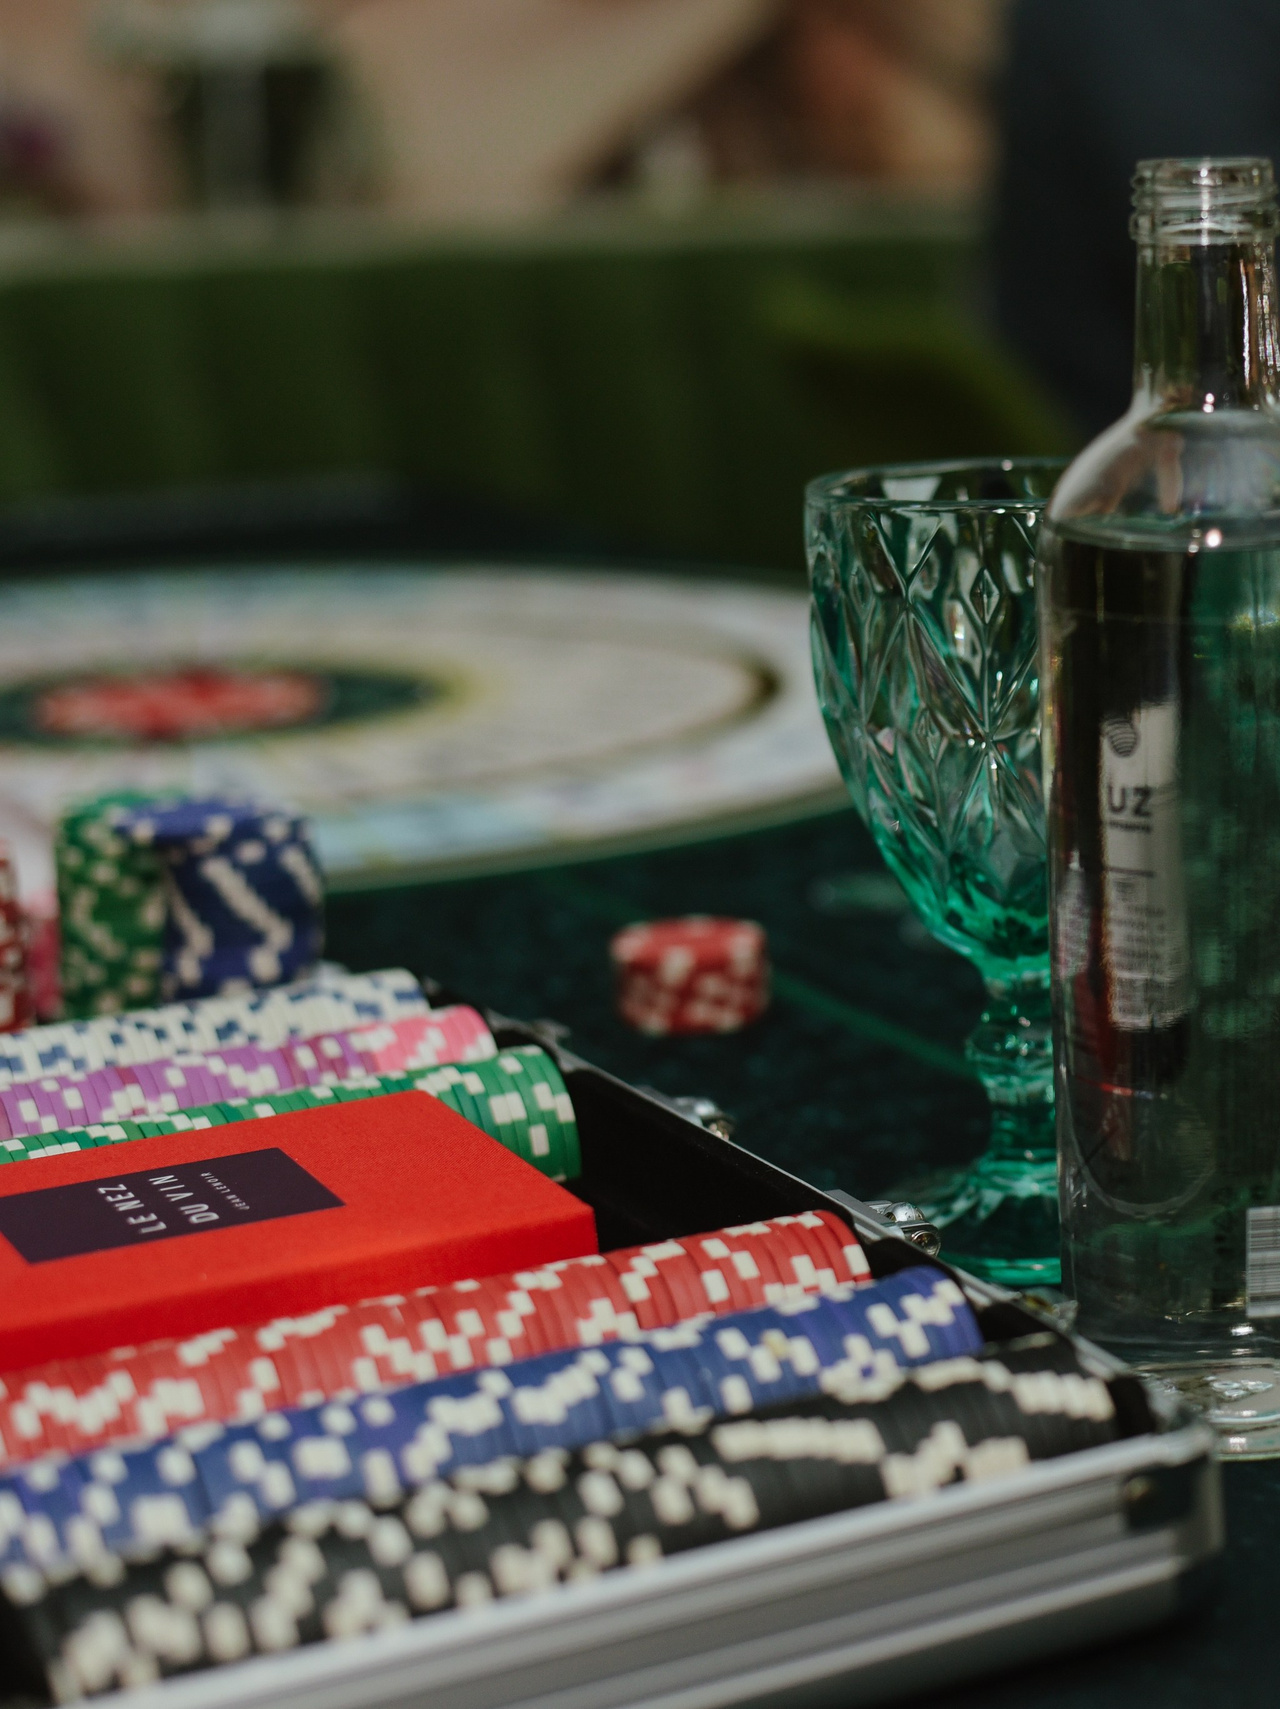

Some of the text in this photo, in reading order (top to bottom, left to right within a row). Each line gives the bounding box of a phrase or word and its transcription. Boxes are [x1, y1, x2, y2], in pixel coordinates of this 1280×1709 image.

[97, 1183, 168, 1235] LE NEZ
[148, 1174, 220, 1225] DU VIN
[200, 1171, 251, 1211] JEAN LENOIR
